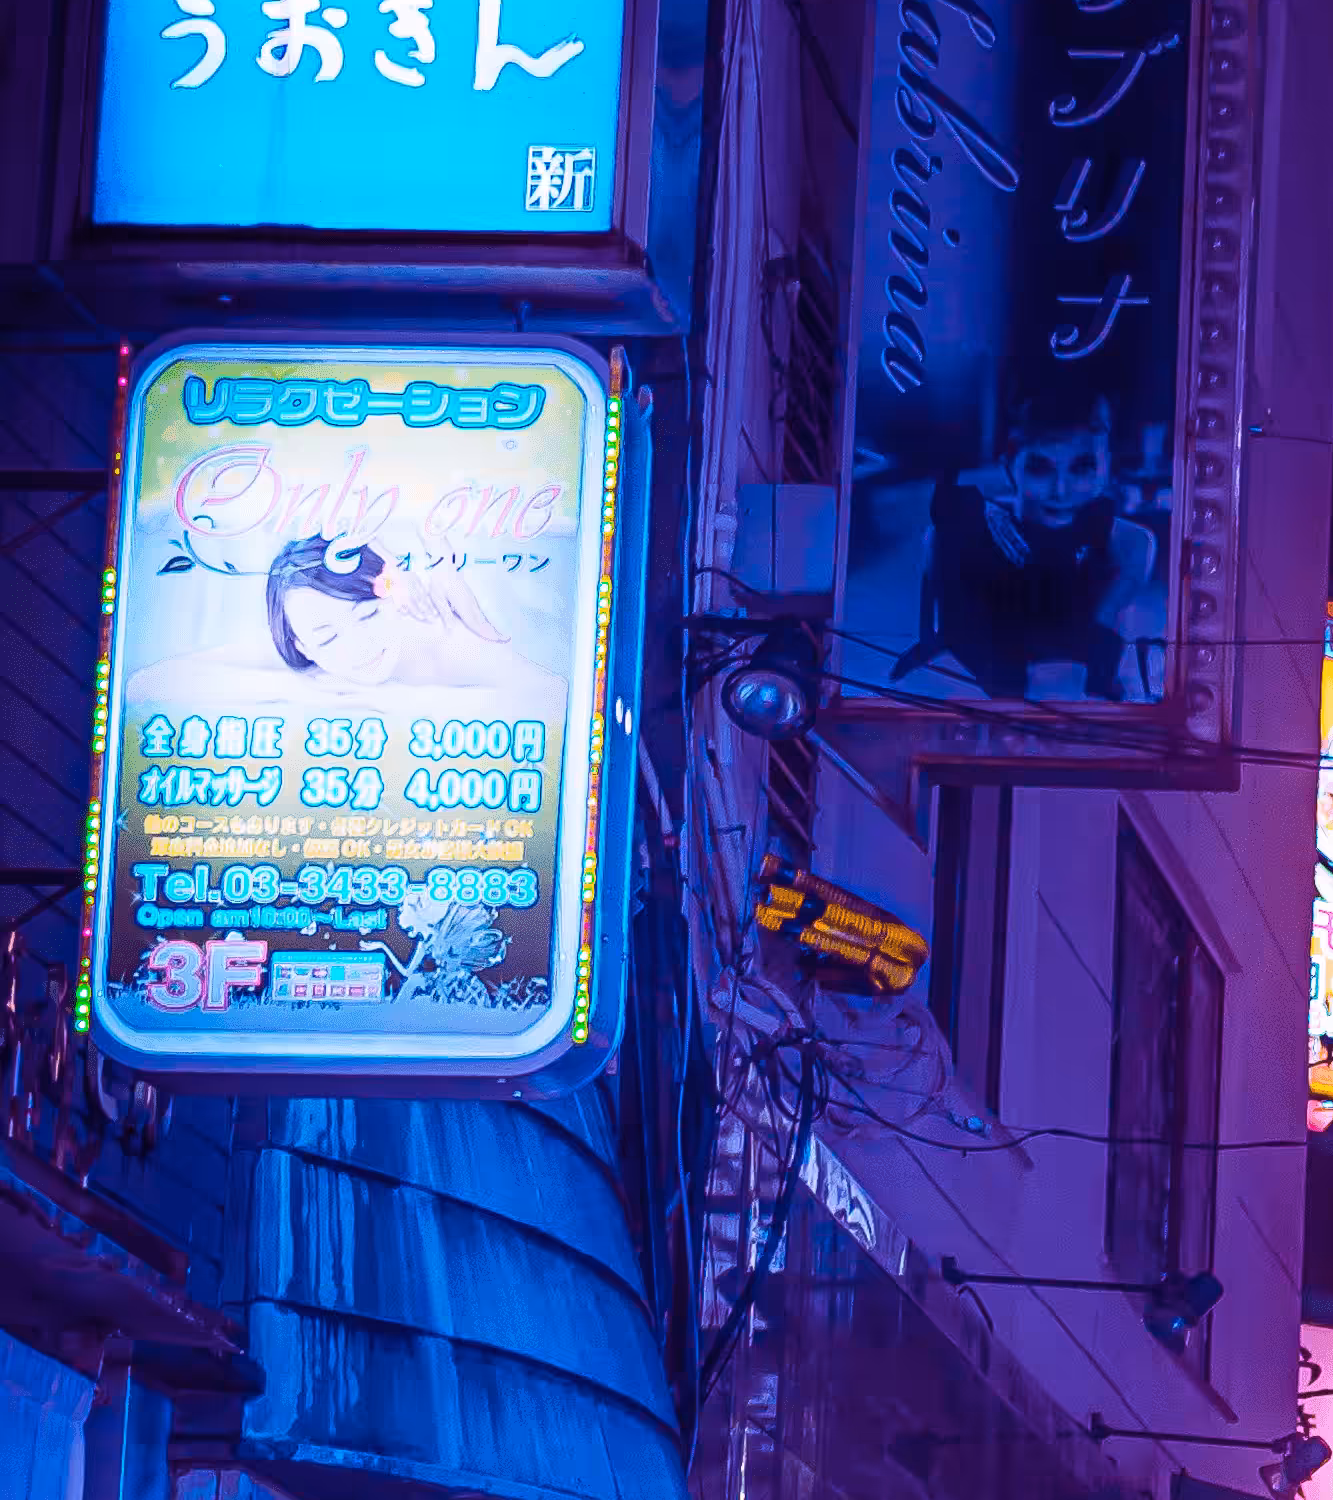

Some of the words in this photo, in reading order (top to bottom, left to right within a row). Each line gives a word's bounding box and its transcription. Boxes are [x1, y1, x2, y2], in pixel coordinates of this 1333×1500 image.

[525, 145, 597, 213] 新
[182, 376, 546, 429] リラクゼーション
[173, 443, 402, 548] Only
[423, 480, 563, 542] one
[395, 550, 552, 575] オンリーワン
[147, 938, 269, 1013] 3F
